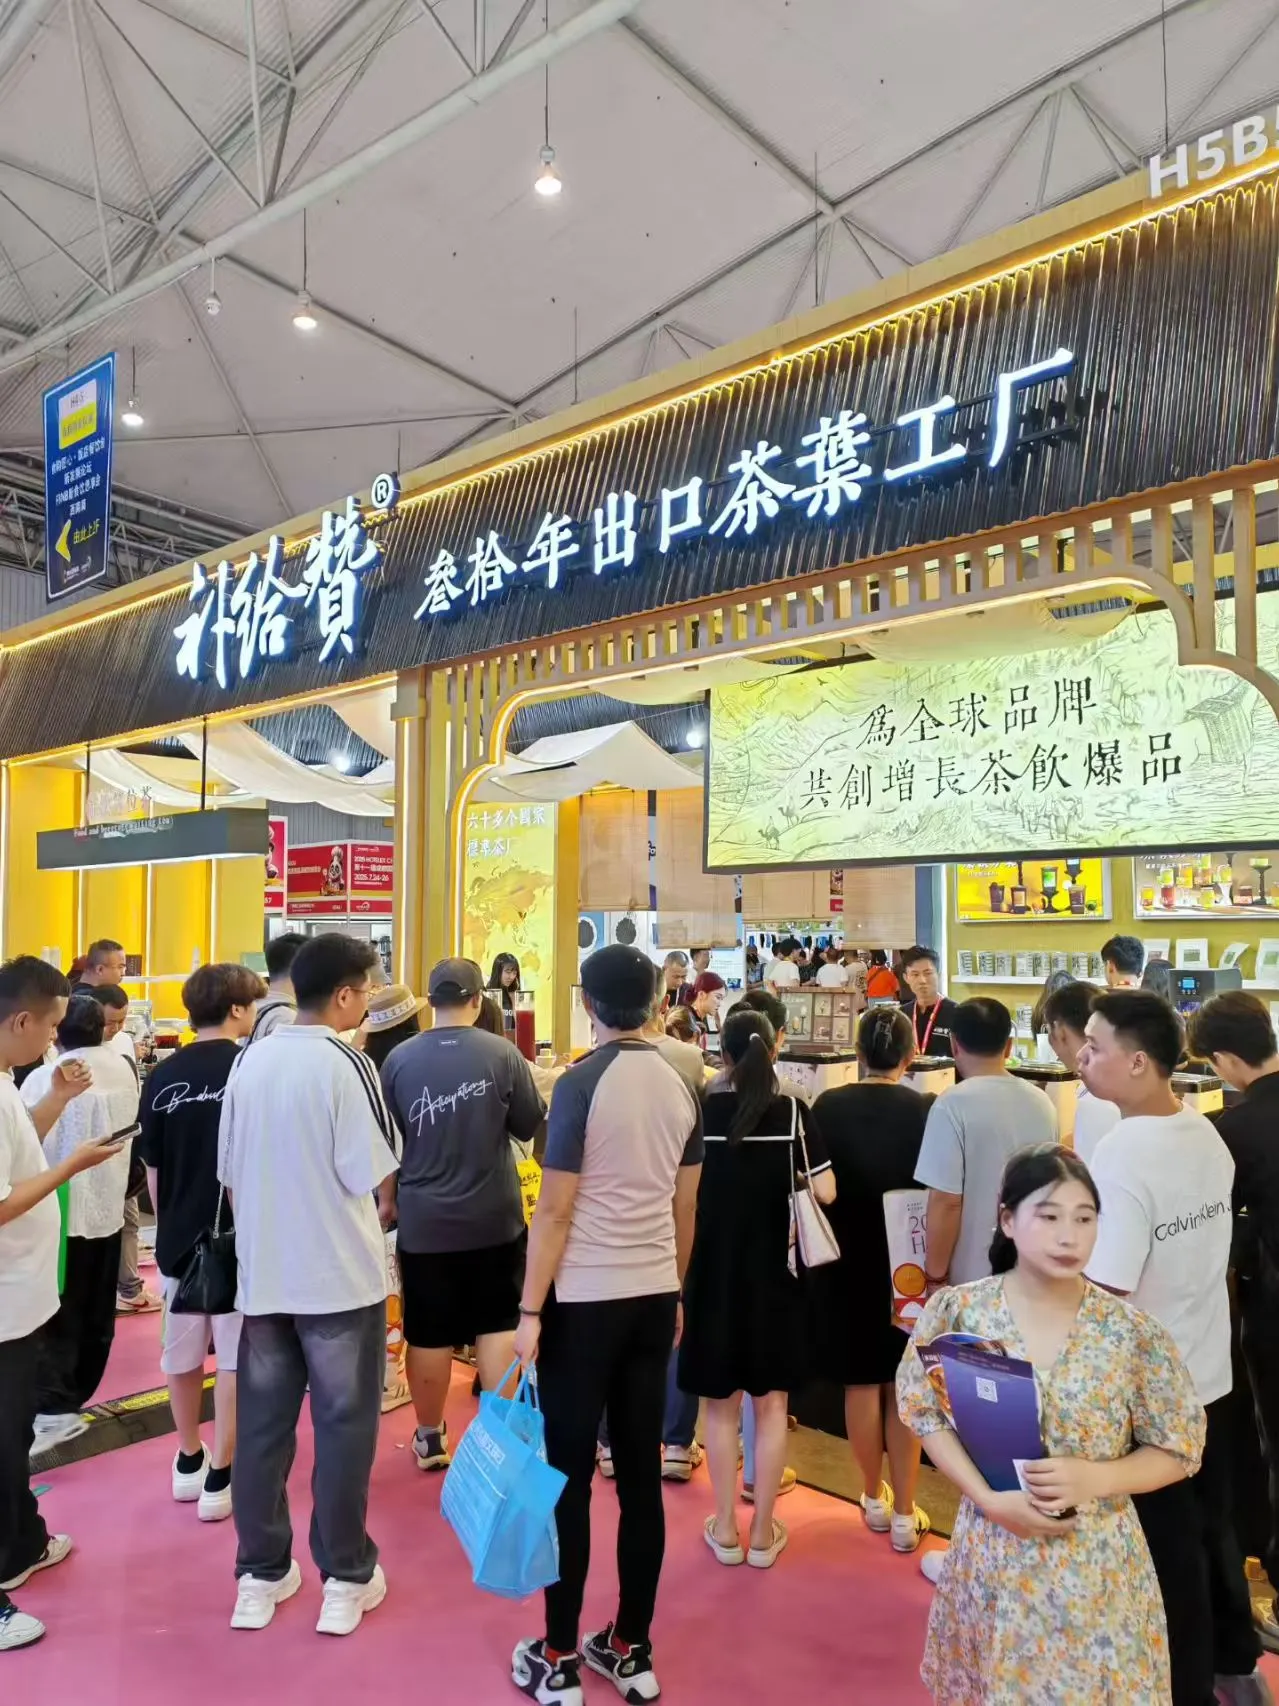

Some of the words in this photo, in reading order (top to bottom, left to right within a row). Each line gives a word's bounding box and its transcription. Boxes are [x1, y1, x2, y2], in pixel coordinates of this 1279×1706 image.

[856, 675, 1097, 750] 為全球品牌
[799, 731, 1183, 811] 共創增長茶飲爆品
